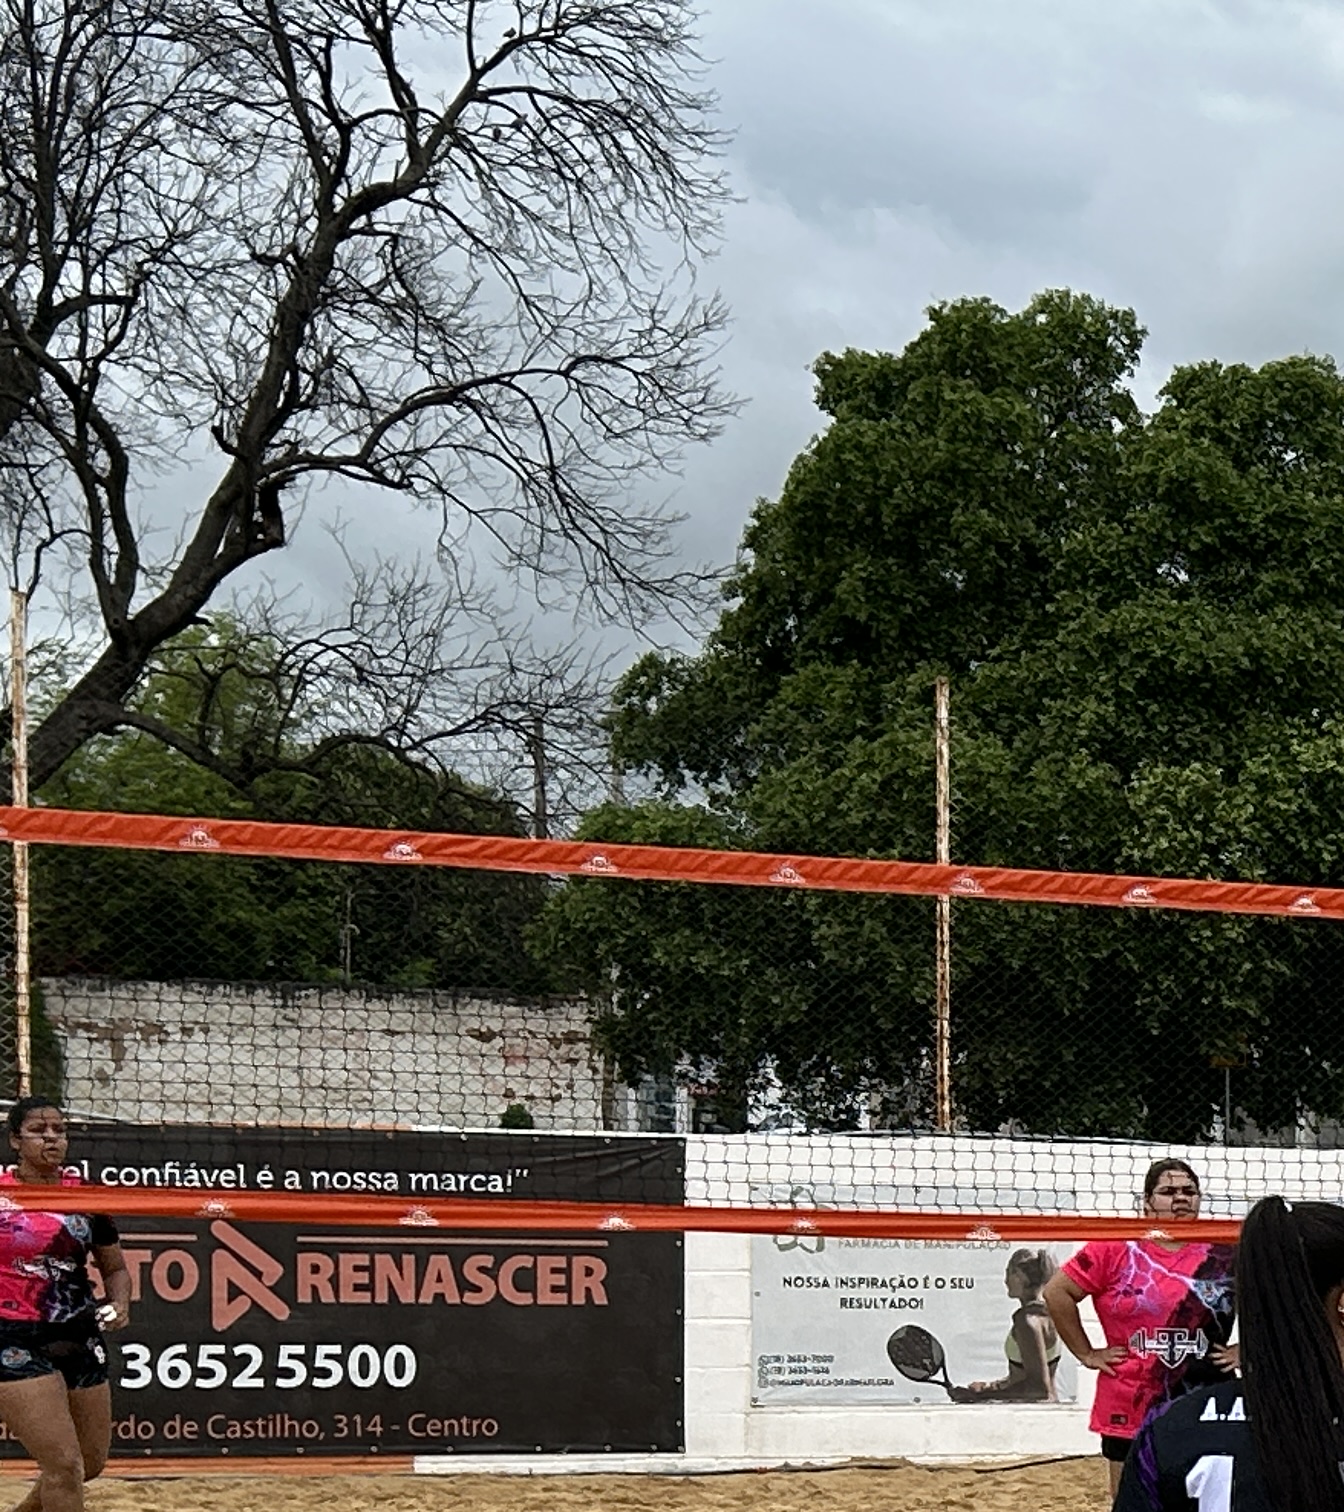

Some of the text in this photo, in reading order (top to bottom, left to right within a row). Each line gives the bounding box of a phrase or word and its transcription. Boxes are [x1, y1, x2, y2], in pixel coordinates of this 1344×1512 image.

[100, 1161, 247, 1188] confiável
[256, 1164, 275, 1189] é
[284, 1170, 302, 1190] a
[311, 1171, 399, 1191] nossa
[297, 1252, 608, 1305] RENASCER
[782, 1274, 975, 1293] NOSSA INSPIRAÇÃO É O SEU
[839, 1297, 924, 1310] RESULTADO!
[163, 1413, 199, 1440] de
[206, 1413, 326, 1441] Castilho,
[333, 1413, 384, 1438] 314
[407, 1413, 499, 1438] Centro
